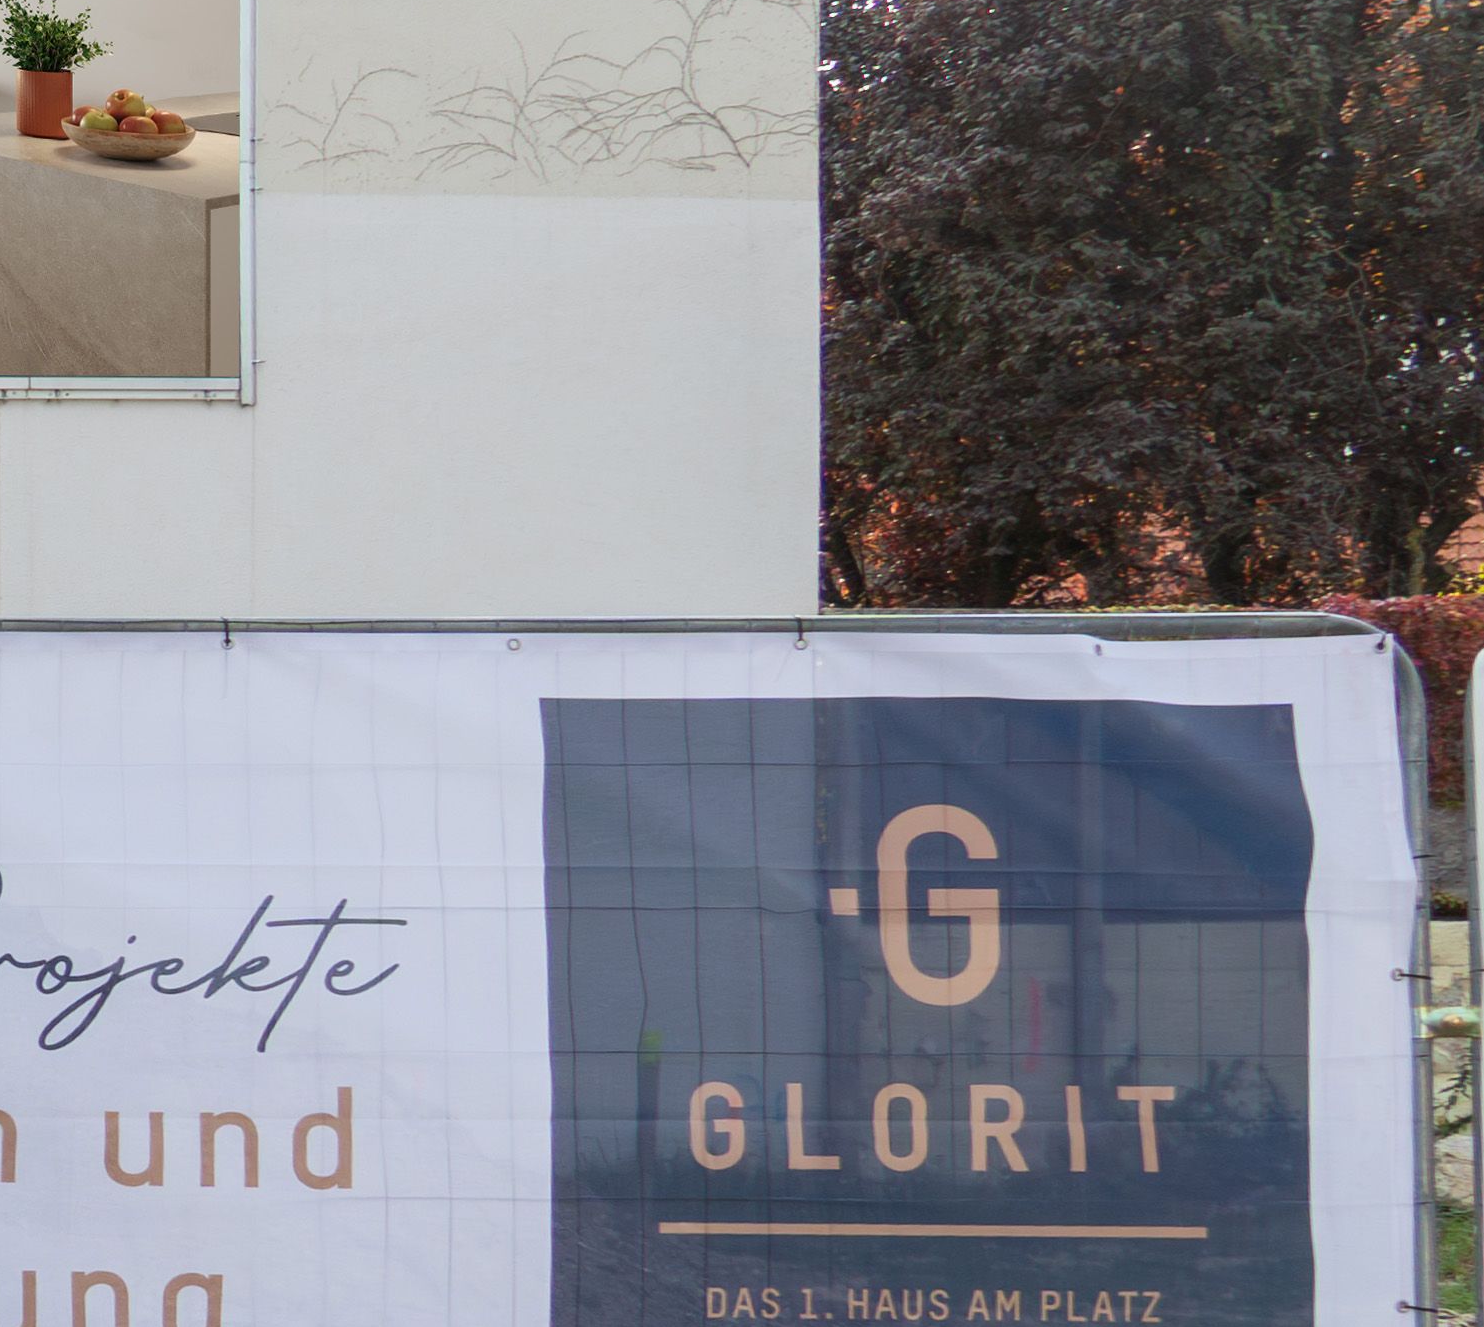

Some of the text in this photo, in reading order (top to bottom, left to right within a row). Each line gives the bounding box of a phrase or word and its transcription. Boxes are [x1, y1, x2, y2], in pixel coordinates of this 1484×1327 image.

[105, 1087, 353, 1189] und
[692, 1084, 1173, 1171] GLORIT
[707, 1288, 1159, 1323] DAS 1. HAUS AM PLATZ
